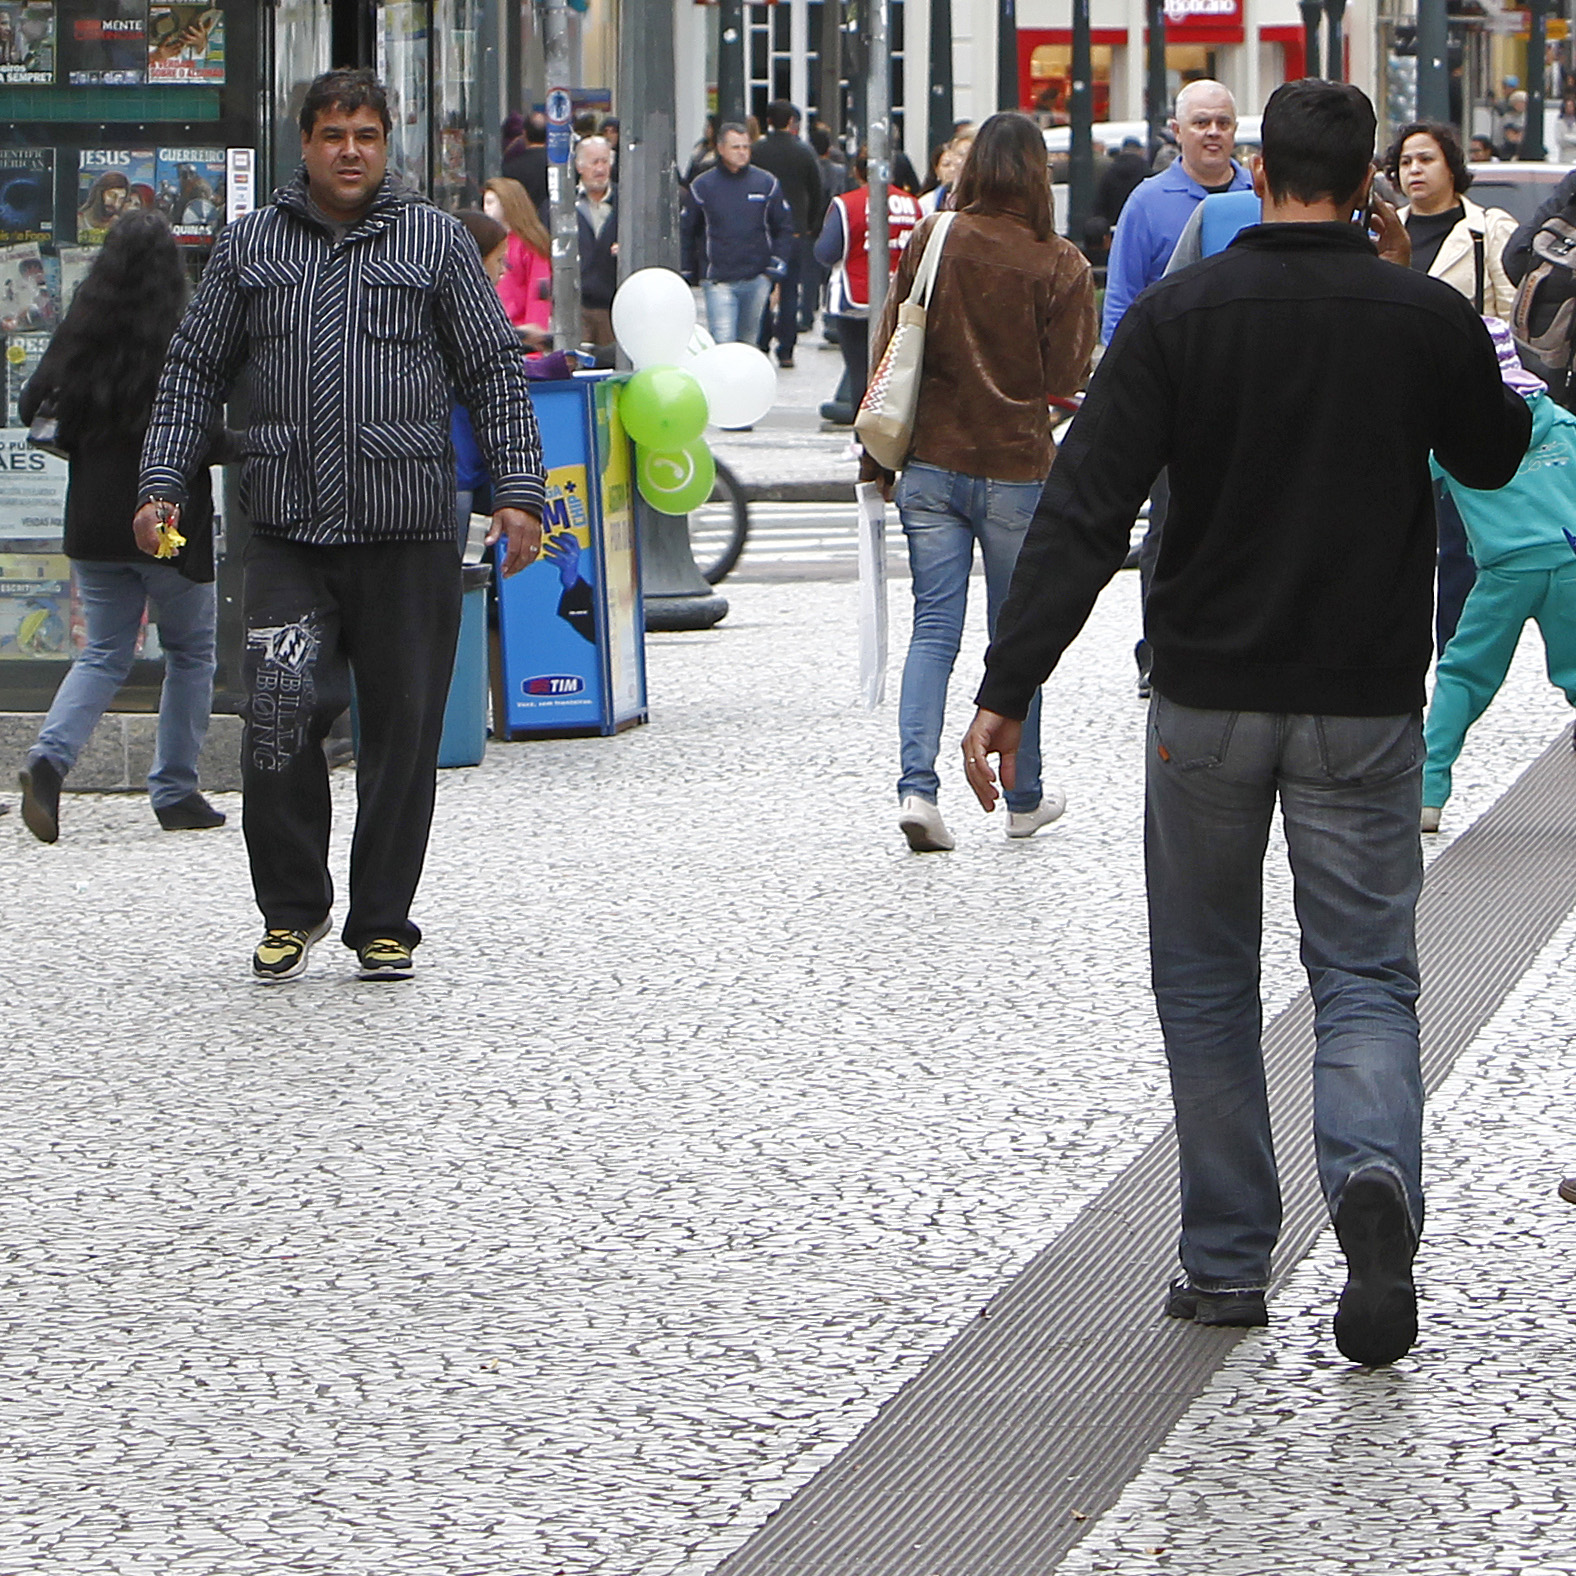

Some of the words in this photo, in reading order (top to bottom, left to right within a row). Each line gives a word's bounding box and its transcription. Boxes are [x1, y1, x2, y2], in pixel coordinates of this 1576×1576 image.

[102, 19, 143, 31] MENTE
[7, 73, 53, 83] SEMPRE?
[79, 150, 130, 168] JESUS
[25, 231, 52, 242] Fogo
[171, 225, 213, 236] QUINAS
[568, 494, 586, 527] CHIP
[549, 678, 578, 693] TIM
